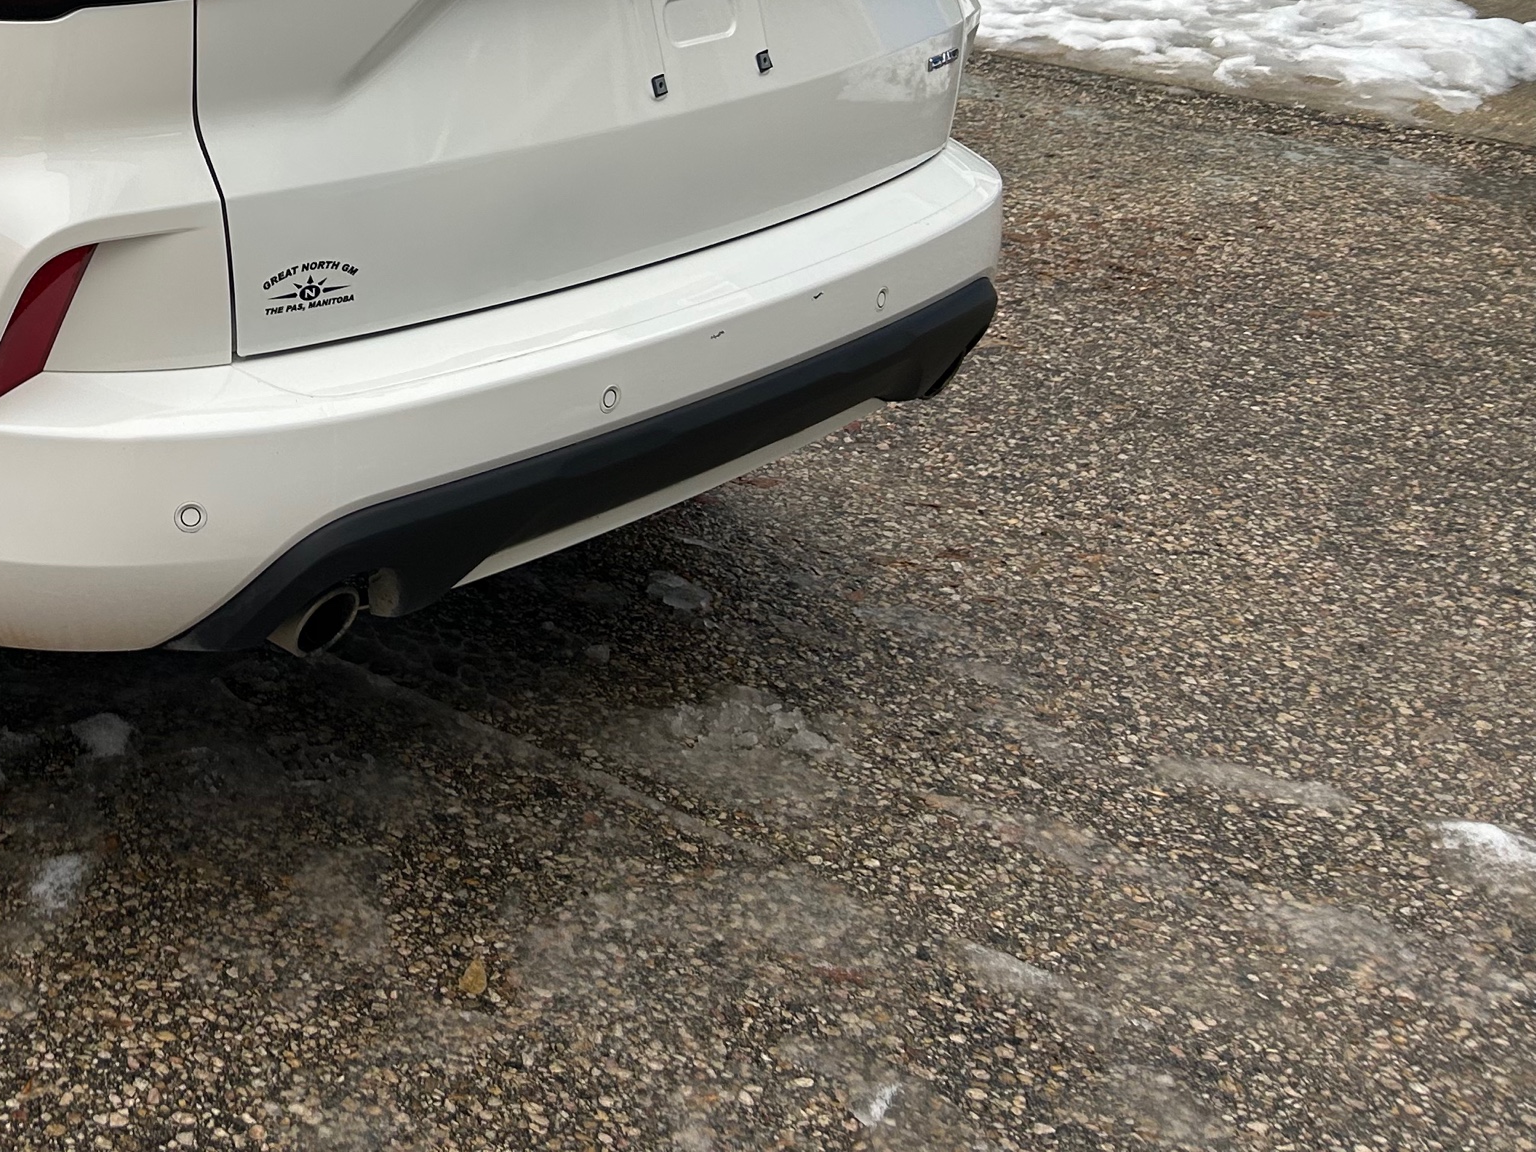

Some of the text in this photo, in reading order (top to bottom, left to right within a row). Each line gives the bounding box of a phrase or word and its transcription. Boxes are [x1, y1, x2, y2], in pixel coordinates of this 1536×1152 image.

[263, 260, 359, 290] GREAT NORTH GM
[304, 287, 316, 299] N
[265, 294, 355, 316] THE PAS, MANITOBA
